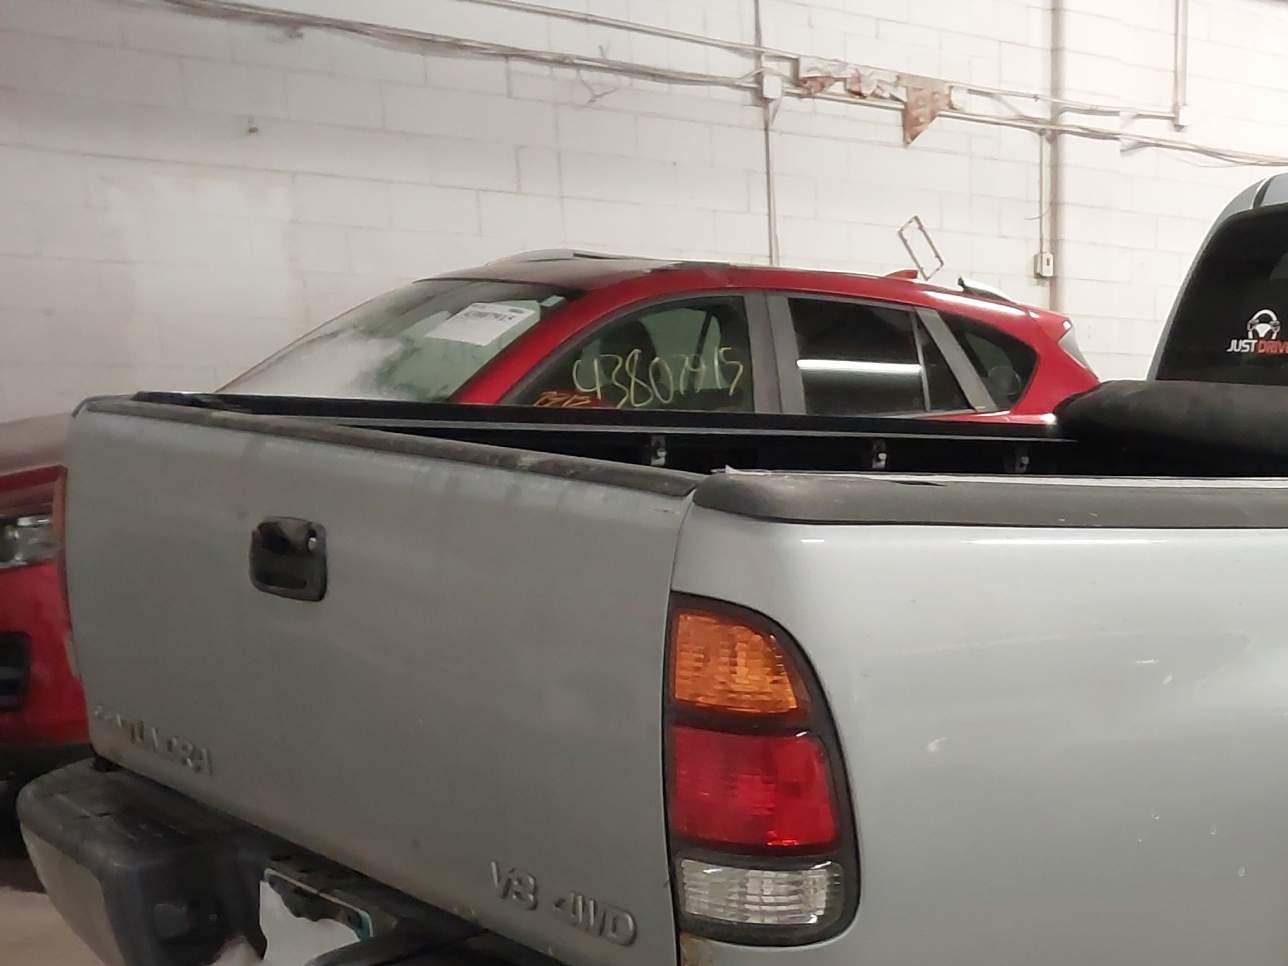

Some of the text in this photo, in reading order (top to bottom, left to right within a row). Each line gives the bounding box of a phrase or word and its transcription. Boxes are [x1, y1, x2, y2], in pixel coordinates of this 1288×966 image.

[1226, 339, 1258, 353] JUST
[490, 860, 638, 947] V8 4WD
